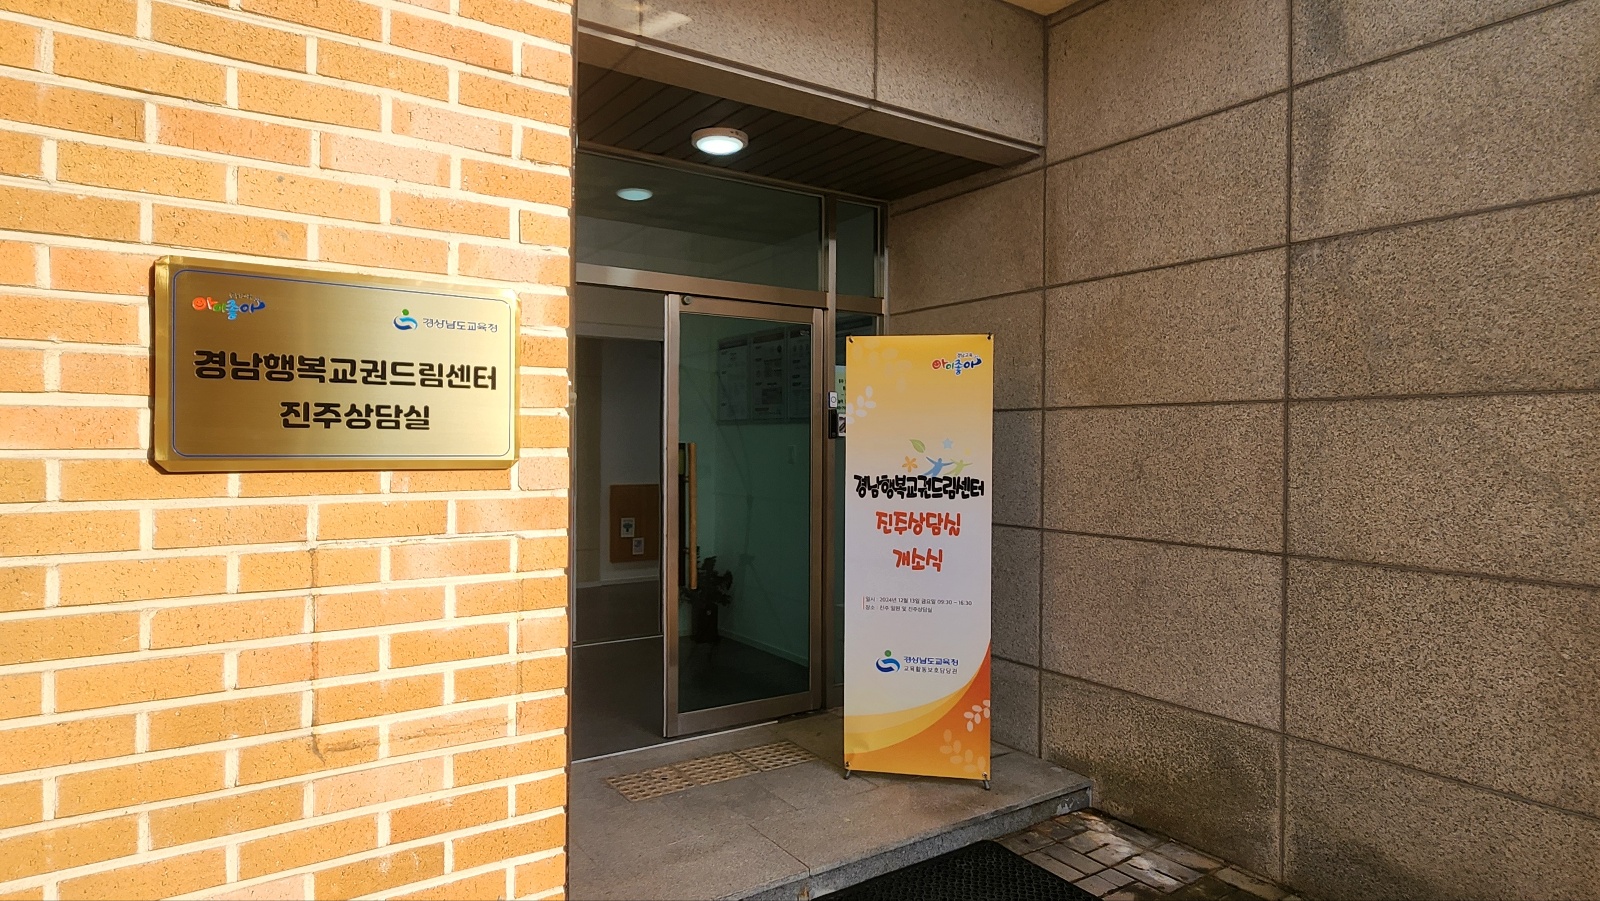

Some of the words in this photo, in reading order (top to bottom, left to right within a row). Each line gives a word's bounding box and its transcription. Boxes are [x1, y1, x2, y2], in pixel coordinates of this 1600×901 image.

[192, 296, 266, 320] 아이좋아
[422, 317, 498, 333] 경상남도교육청
[193, 349, 498, 391] 경남행복교권드림센터
[931, 357, 982, 375] 아이좋아
[279, 401, 431, 431] 진주상담실
[853, 474, 985, 500] 경남행복교권드림센터
[875, 511, 961, 537] 진주상담실
[892, 547, 943, 572] 개소식
[903, 655, 959, 667] 경상남도교육청
[904, 665, 958, 675] 교육활동보호담당관
